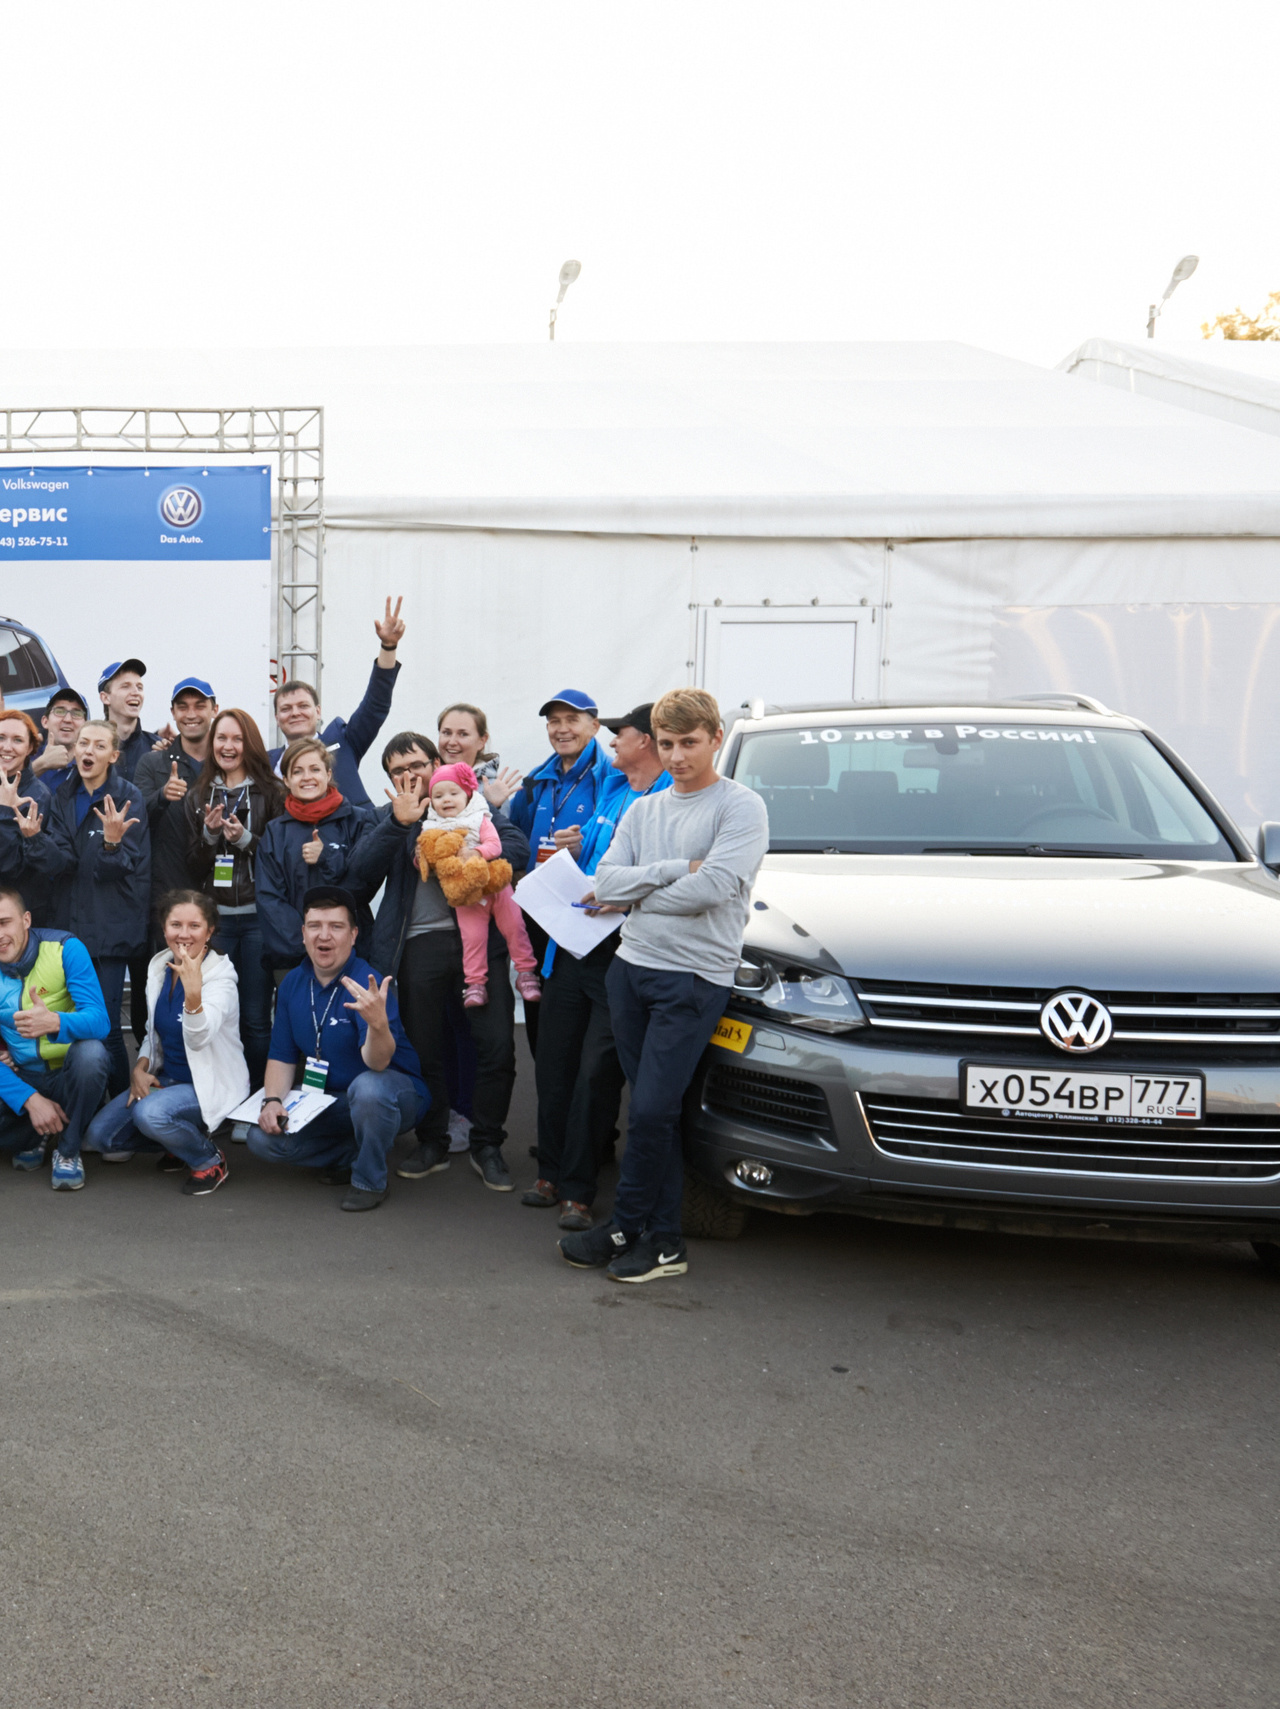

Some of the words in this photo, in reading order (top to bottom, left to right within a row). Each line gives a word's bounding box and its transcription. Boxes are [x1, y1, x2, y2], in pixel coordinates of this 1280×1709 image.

[2, 479, 70, 493] Volkswagen
[18, 536, 69, 547] 526-75-11
[160, 534, 177, 544] Das
[179, 534, 204, 544] Auto.
[798, 728, 843, 746] 10
[854, 727, 913, 742] лет
[924, 727, 945, 740] в
[954, 724, 1098, 745] России!
[1134, 1079, 1191, 1106] 777
[1146, 1105, 1175, 1116] RUS
